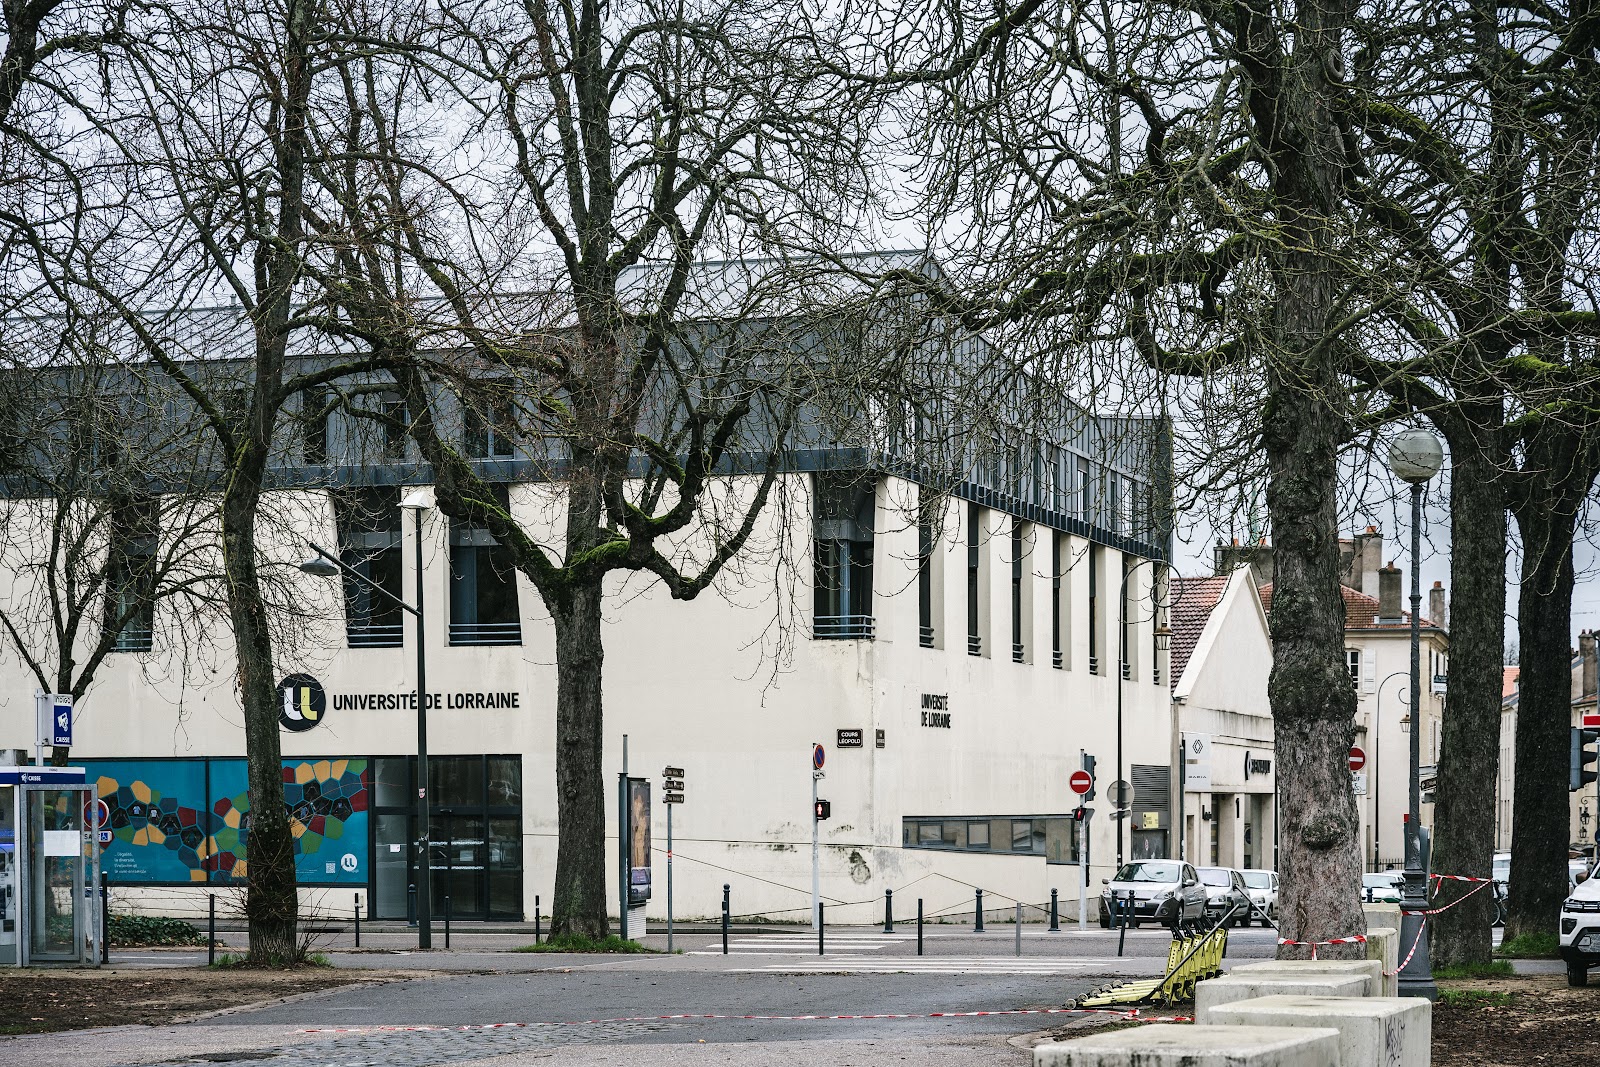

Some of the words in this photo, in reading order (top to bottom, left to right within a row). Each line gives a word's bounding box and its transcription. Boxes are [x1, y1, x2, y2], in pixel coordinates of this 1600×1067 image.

[333, 690, 418, 710] UNIVERSITÉ
[447, 692, 520, 709] LORRAINE
[921, 694, 948, 711] UNIVERSITÉ
[921, 711, 927, 727] DE
[928, 711, 951, 729] LORRAINE
